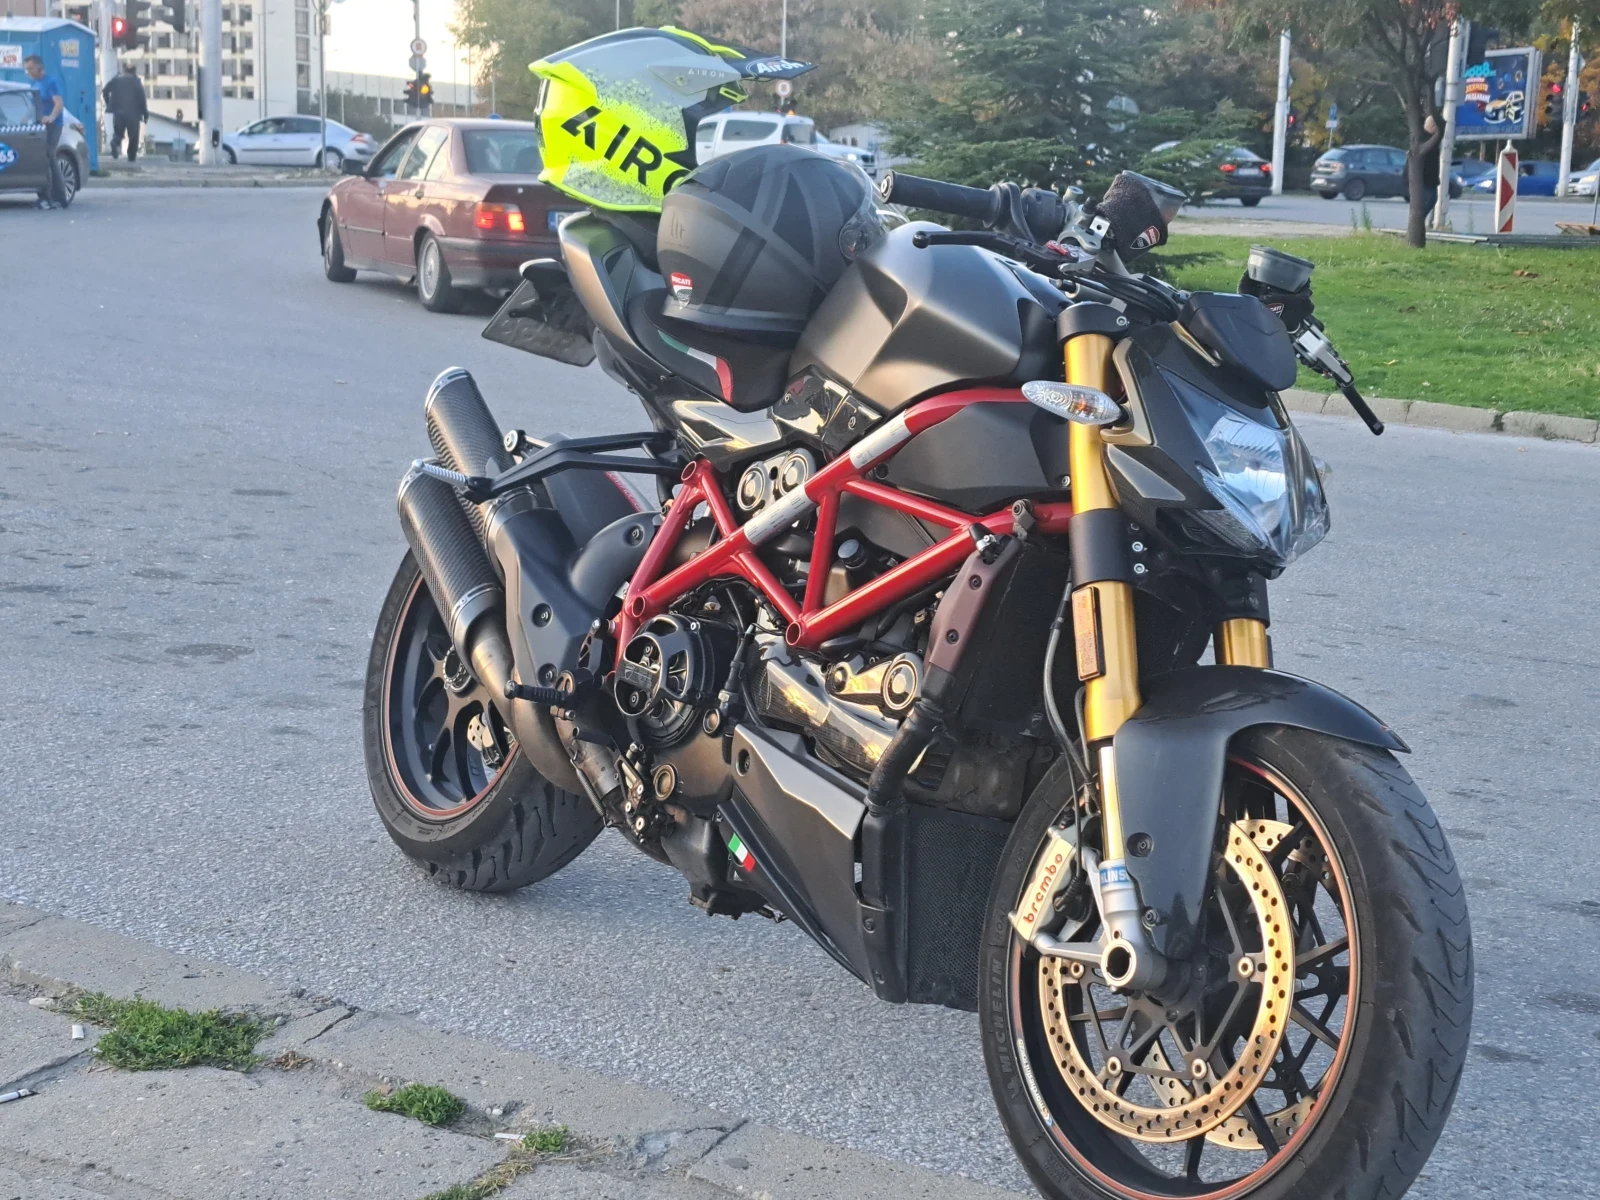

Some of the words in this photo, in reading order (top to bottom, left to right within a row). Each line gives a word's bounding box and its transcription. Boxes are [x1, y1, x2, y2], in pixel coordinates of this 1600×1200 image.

[688, 69, 725, 78] AIROH
[755, 60, 804, 74] Airoh
[561, 105, 693, 196] AIR
[1023, 853, 1063, 925] brembo
[992, 958, 1013, 1073] MICHELIN
